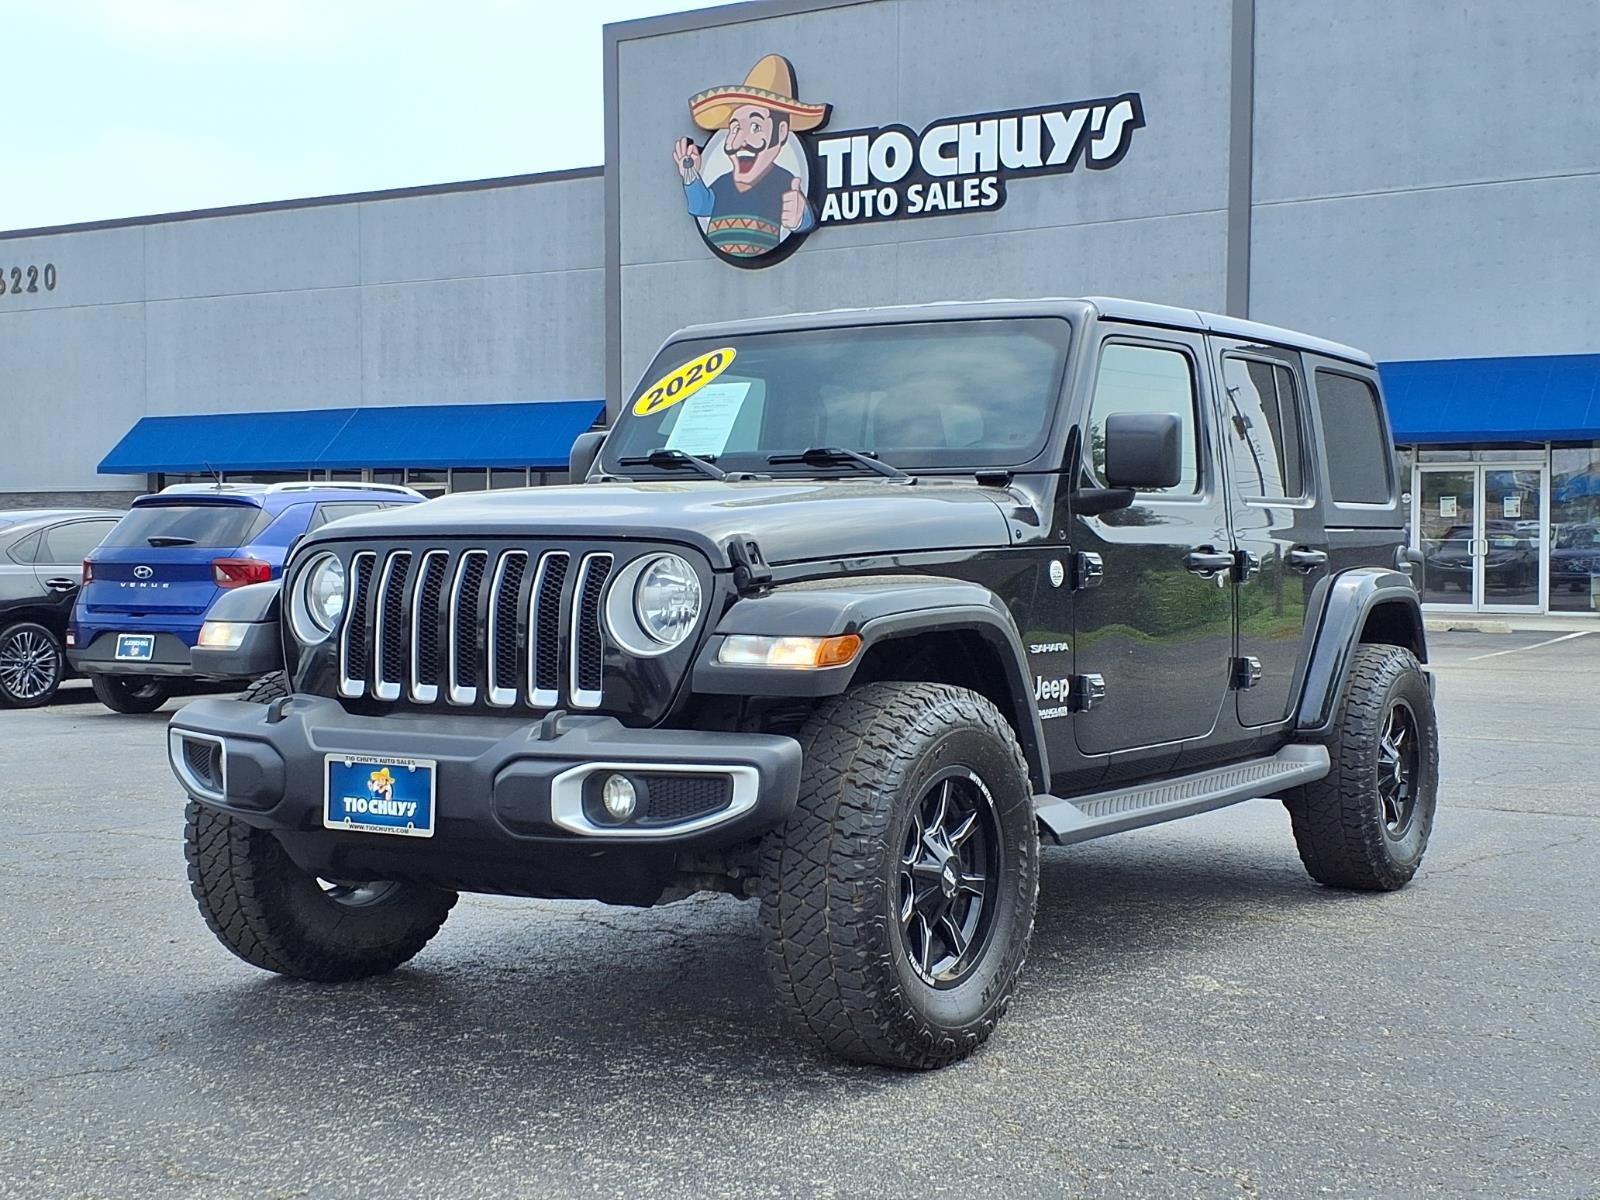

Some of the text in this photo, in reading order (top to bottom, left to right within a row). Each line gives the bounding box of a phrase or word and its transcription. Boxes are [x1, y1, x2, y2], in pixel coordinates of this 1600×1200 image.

[818, 100, 1134, 189] TIO CHUY'S
[820, 176, 998, 222] AUTO SALES
[646, 353, 723, 411] 2020
[1030, 642, 1069, 653] SAHARA
[1034, 675, 1070, 702] Jeep
[343, 797, 417, 817] TIO CHUY'S
